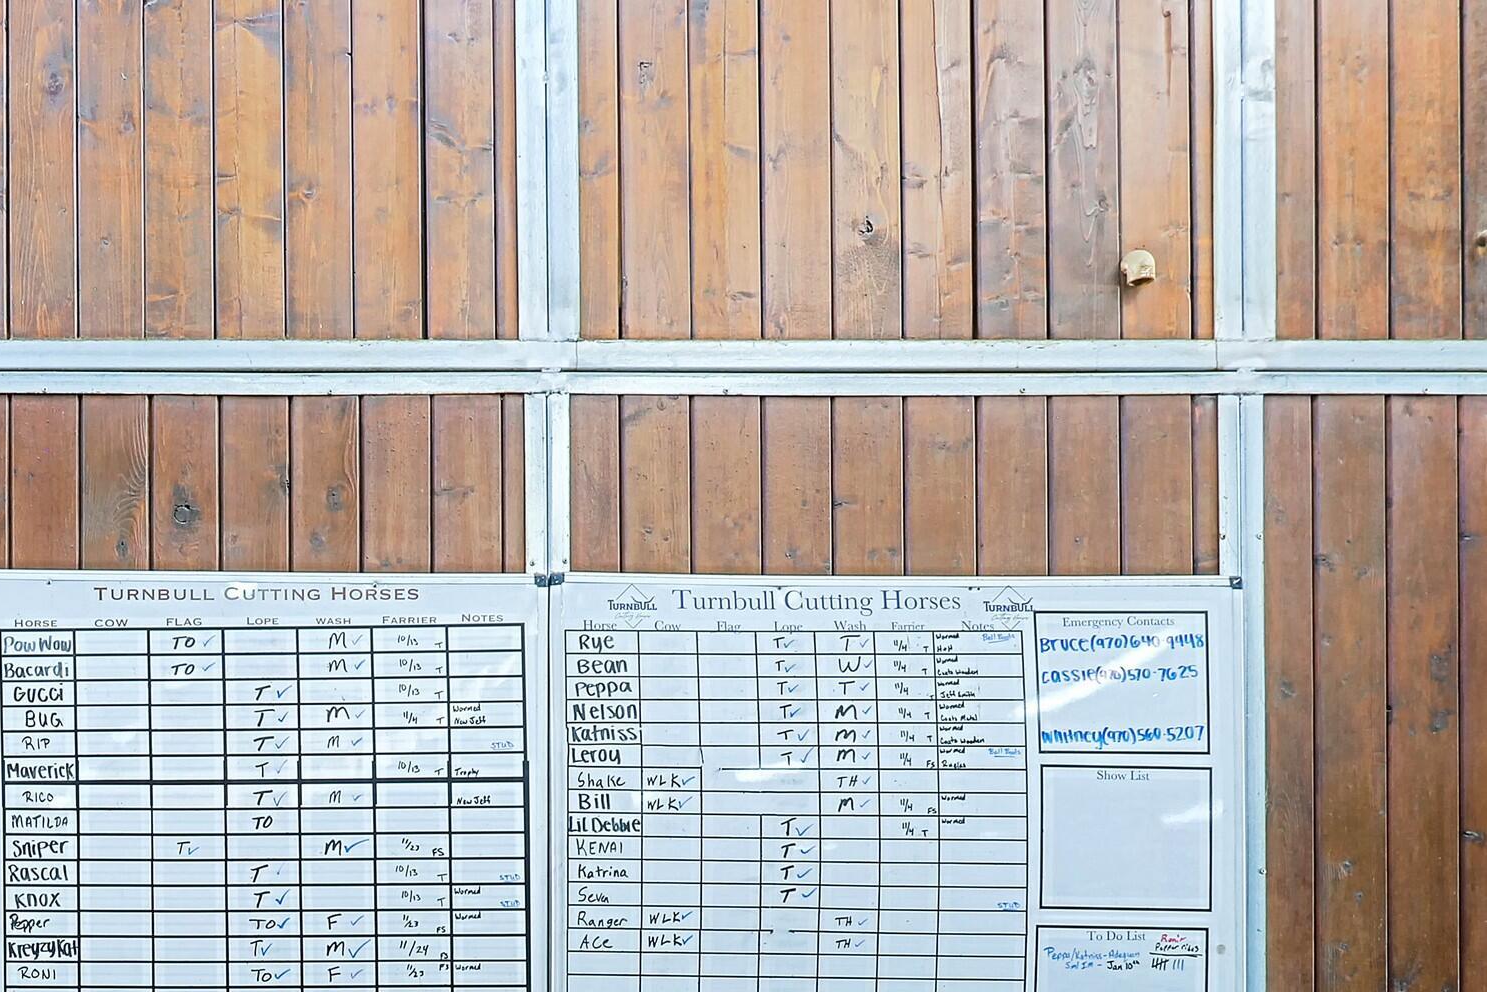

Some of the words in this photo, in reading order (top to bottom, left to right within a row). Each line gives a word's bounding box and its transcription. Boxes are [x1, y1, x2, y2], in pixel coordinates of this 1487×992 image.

[94, 587, 216, 600] TURNBULL
[224, 586, 321, 601] CUTTING
[331, 587, 420, 600] HORSES
[608, 596, 658, 611] TURNBULL
[672, 589, 776, 610] Turnbull
[784, 589, 874, 616] Cutting
[881, 590, 961, 610] Horses
[983, 597, 1034, 612] TURNBULL
[94, 619, 128, 627] COW
[166, 618, 202, 626] FLAG
[246, 617, 279, 625] LOPE
[382, 616, 437, 624] FARRIER
[462, 614, 503, 622] NOTES
[1063, 617, 1124, 629] Emergency
[1127, 616, 1175, 626] Contacts
[583, 620, 617, 631] Horse
[654, 620, 681, 631] Cow
[834, 620, 867, 631] Wash
[891, 622, 926, 631] Farrier
[962, 621, 994, 631] Notes
[579, 634, 615, 653] Rye
[4, 662, 69, 679] Bacardi
[577, 659, 628, 674] Bean
[25, 711, 63, 727] BUG
[573, 703, 637, 721] Nelson
[572, 726, 638, 742] Katniss
[22, 737, 50, 751] RIP
[6, 763, 75, 780] Maverick
[1097, 770, 1127, 780] Show
[1131, 771, 1149, 781] List
[22, 791, 54, 803] RICO
[578, 793, 611, 810] Bill
[12, 814, 68, 828] MATILDA
[12, 838, 69, 859] Sniper
[8, 865, 68, 882] Rascal
[578, 864, 629, 879] Katrina
[577, 911, 628, 928] Ranger
[1087, 931, 1102, 941] To
[1107, 931, 1123, 940] Do
[1127, 931, 1146, 941] List
[18, 967, 56, 980] RONI
